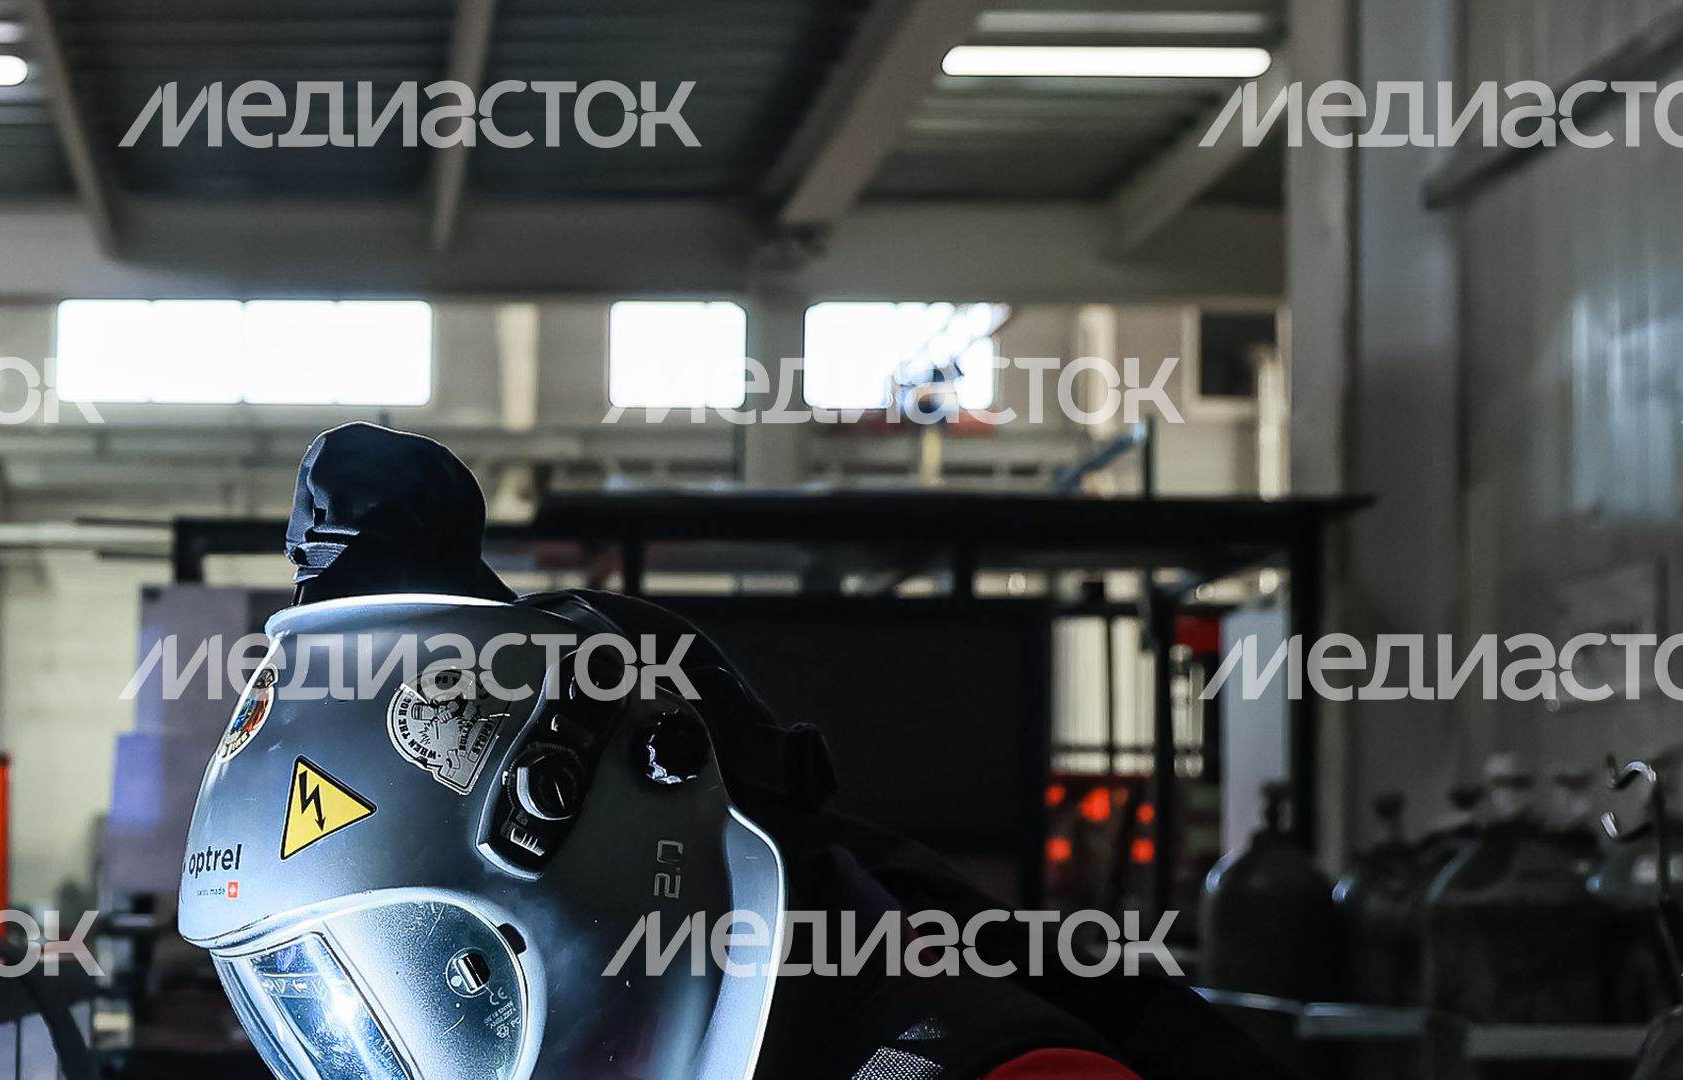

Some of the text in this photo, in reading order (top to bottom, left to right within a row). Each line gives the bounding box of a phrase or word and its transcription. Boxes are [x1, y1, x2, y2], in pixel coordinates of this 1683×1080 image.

[398, 718, 412, 740] THE
[407, 739, 438, 760] WHEN
[188, 844, 243, 879] optrel
[653, 839, 683, 899] 2.0
